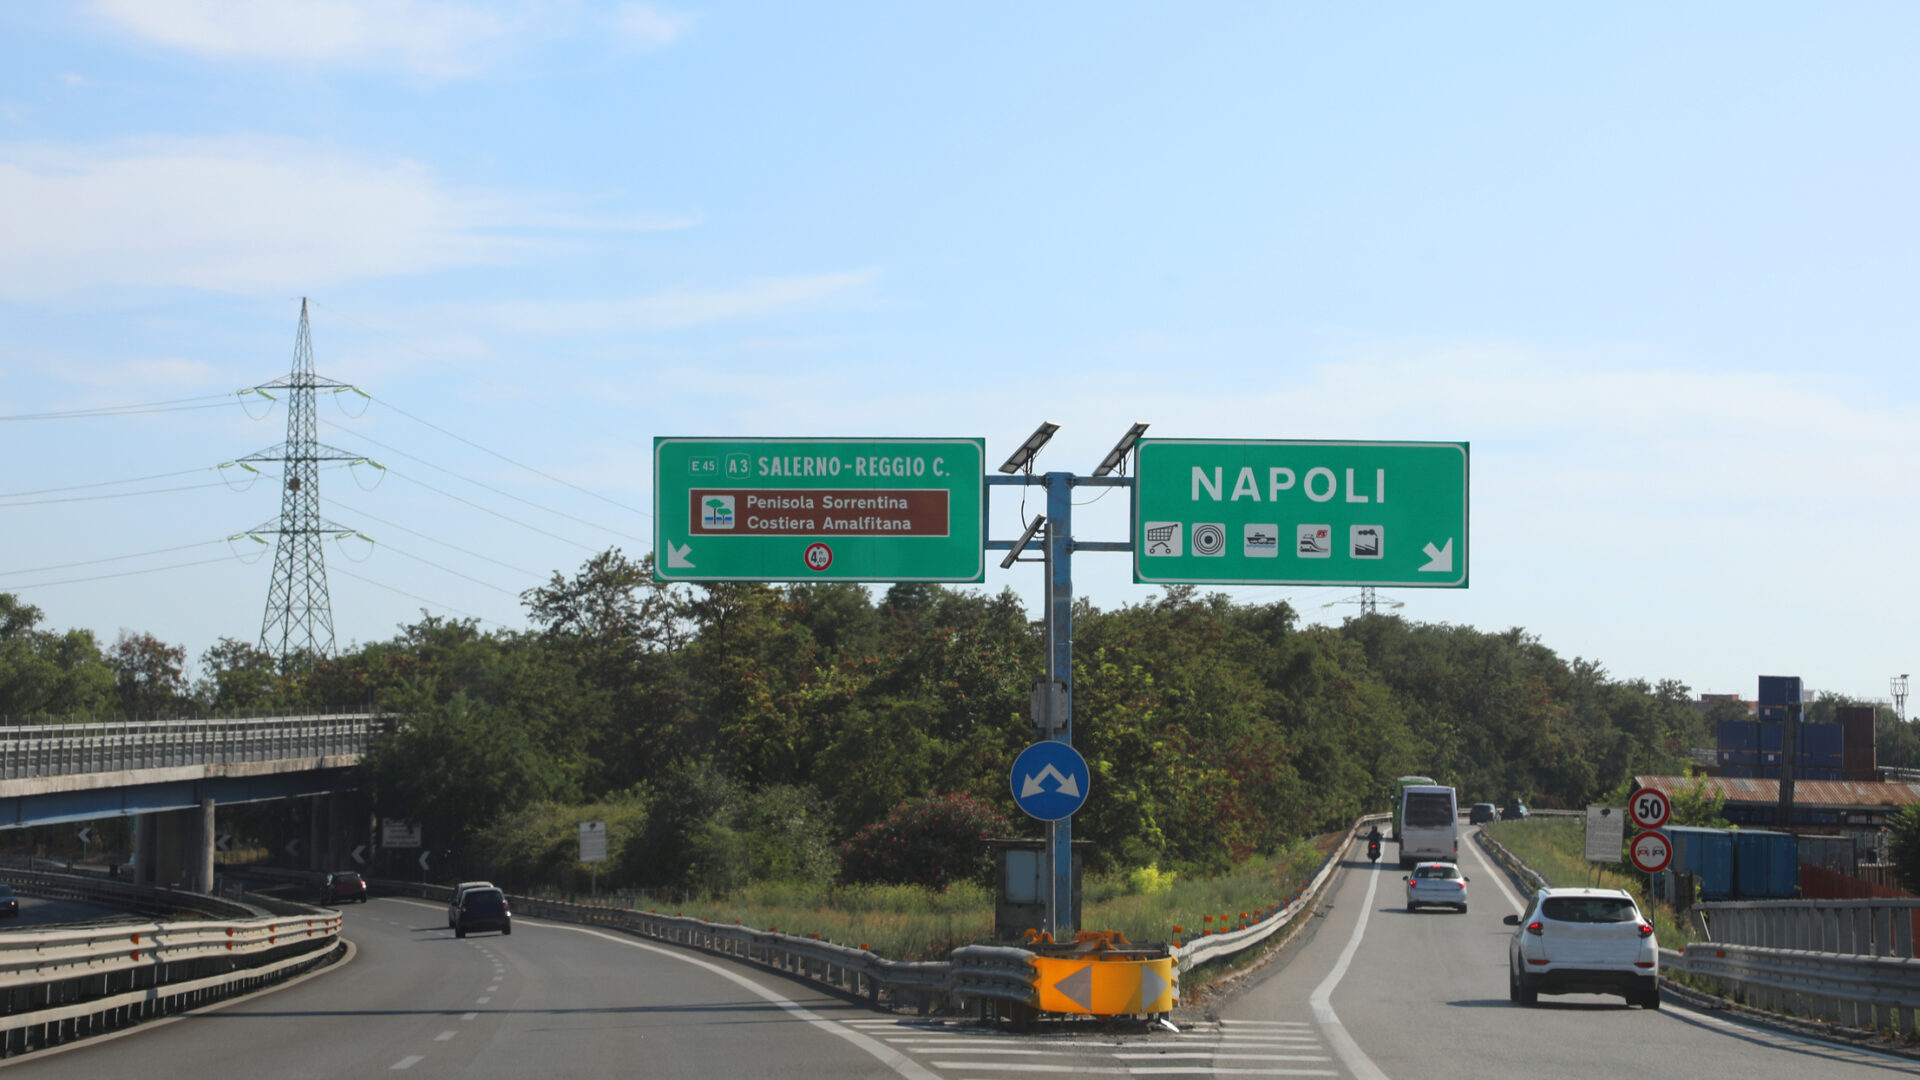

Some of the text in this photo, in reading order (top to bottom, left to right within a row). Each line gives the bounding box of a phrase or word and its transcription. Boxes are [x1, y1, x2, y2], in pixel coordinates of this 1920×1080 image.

[692, 461, 715, 471] E 45
[729, 459, 748, 473] A 3
[932, 456, 950, 476] C.
[1191, 466, 1385, 503] NAPOLI
[747, 495, 908, 509] Penisola Sorrentina
[747, 516, 912, 530] Costiera Amalfitana
[1638, 799, 1662, 819] 50
